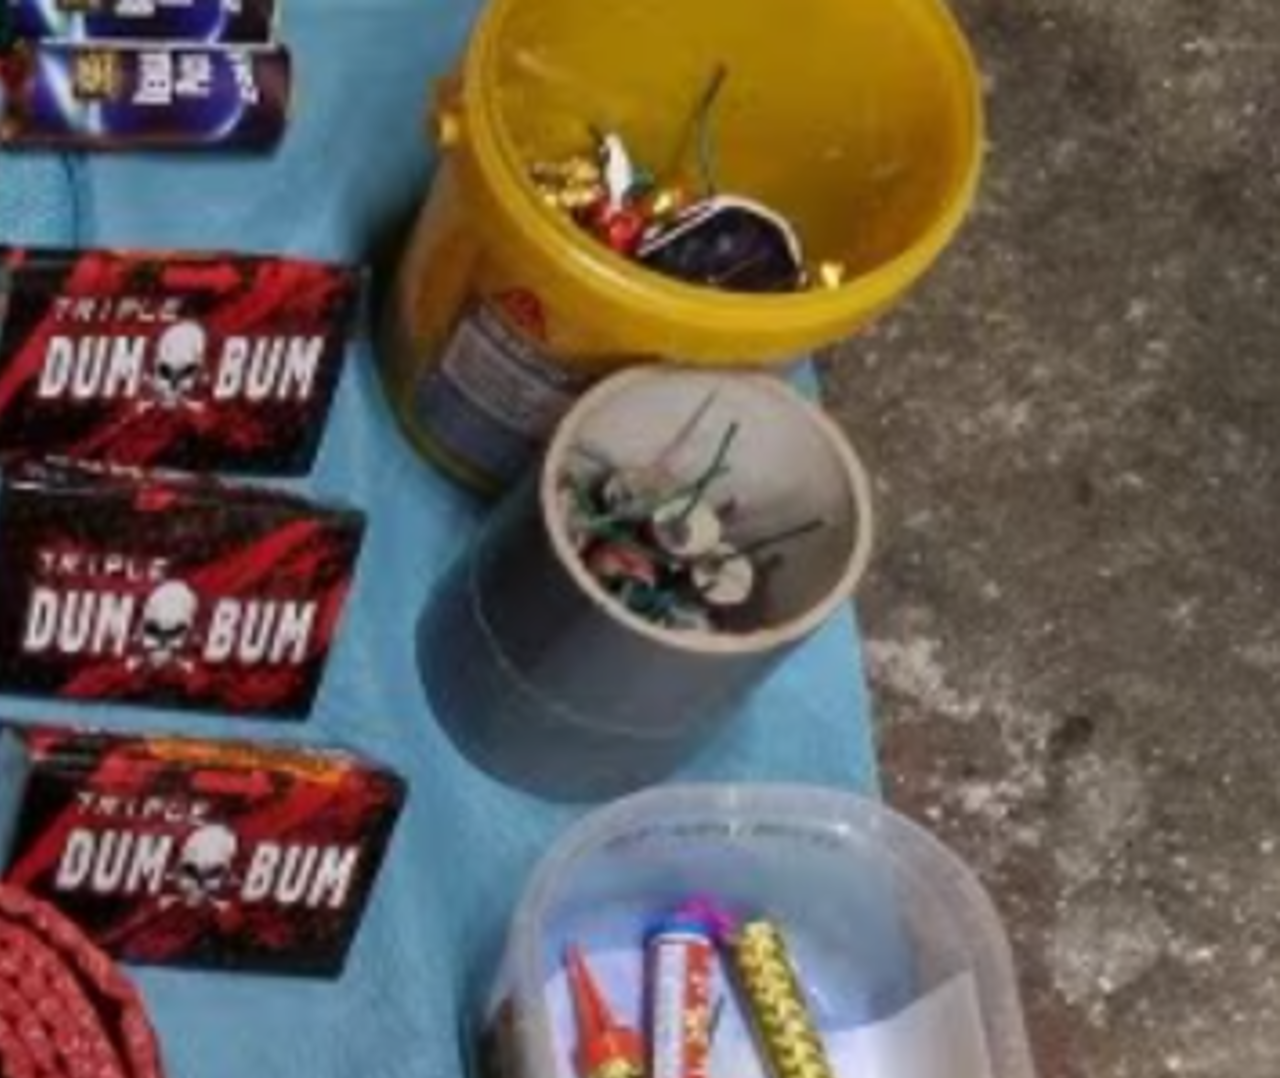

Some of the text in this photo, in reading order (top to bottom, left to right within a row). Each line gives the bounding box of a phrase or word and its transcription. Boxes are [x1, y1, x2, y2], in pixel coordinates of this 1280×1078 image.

[54, 298, 182, 322] TRIPLE
[38, 336, 325, 399] DUM BUM
[40, 553, 170, 582] TRIPLE
[23, 588, 316, 664] DUM BUM
[77, 793, 209, 824] TRIPLE
[55, 829, 360, 909] DUM BUM
